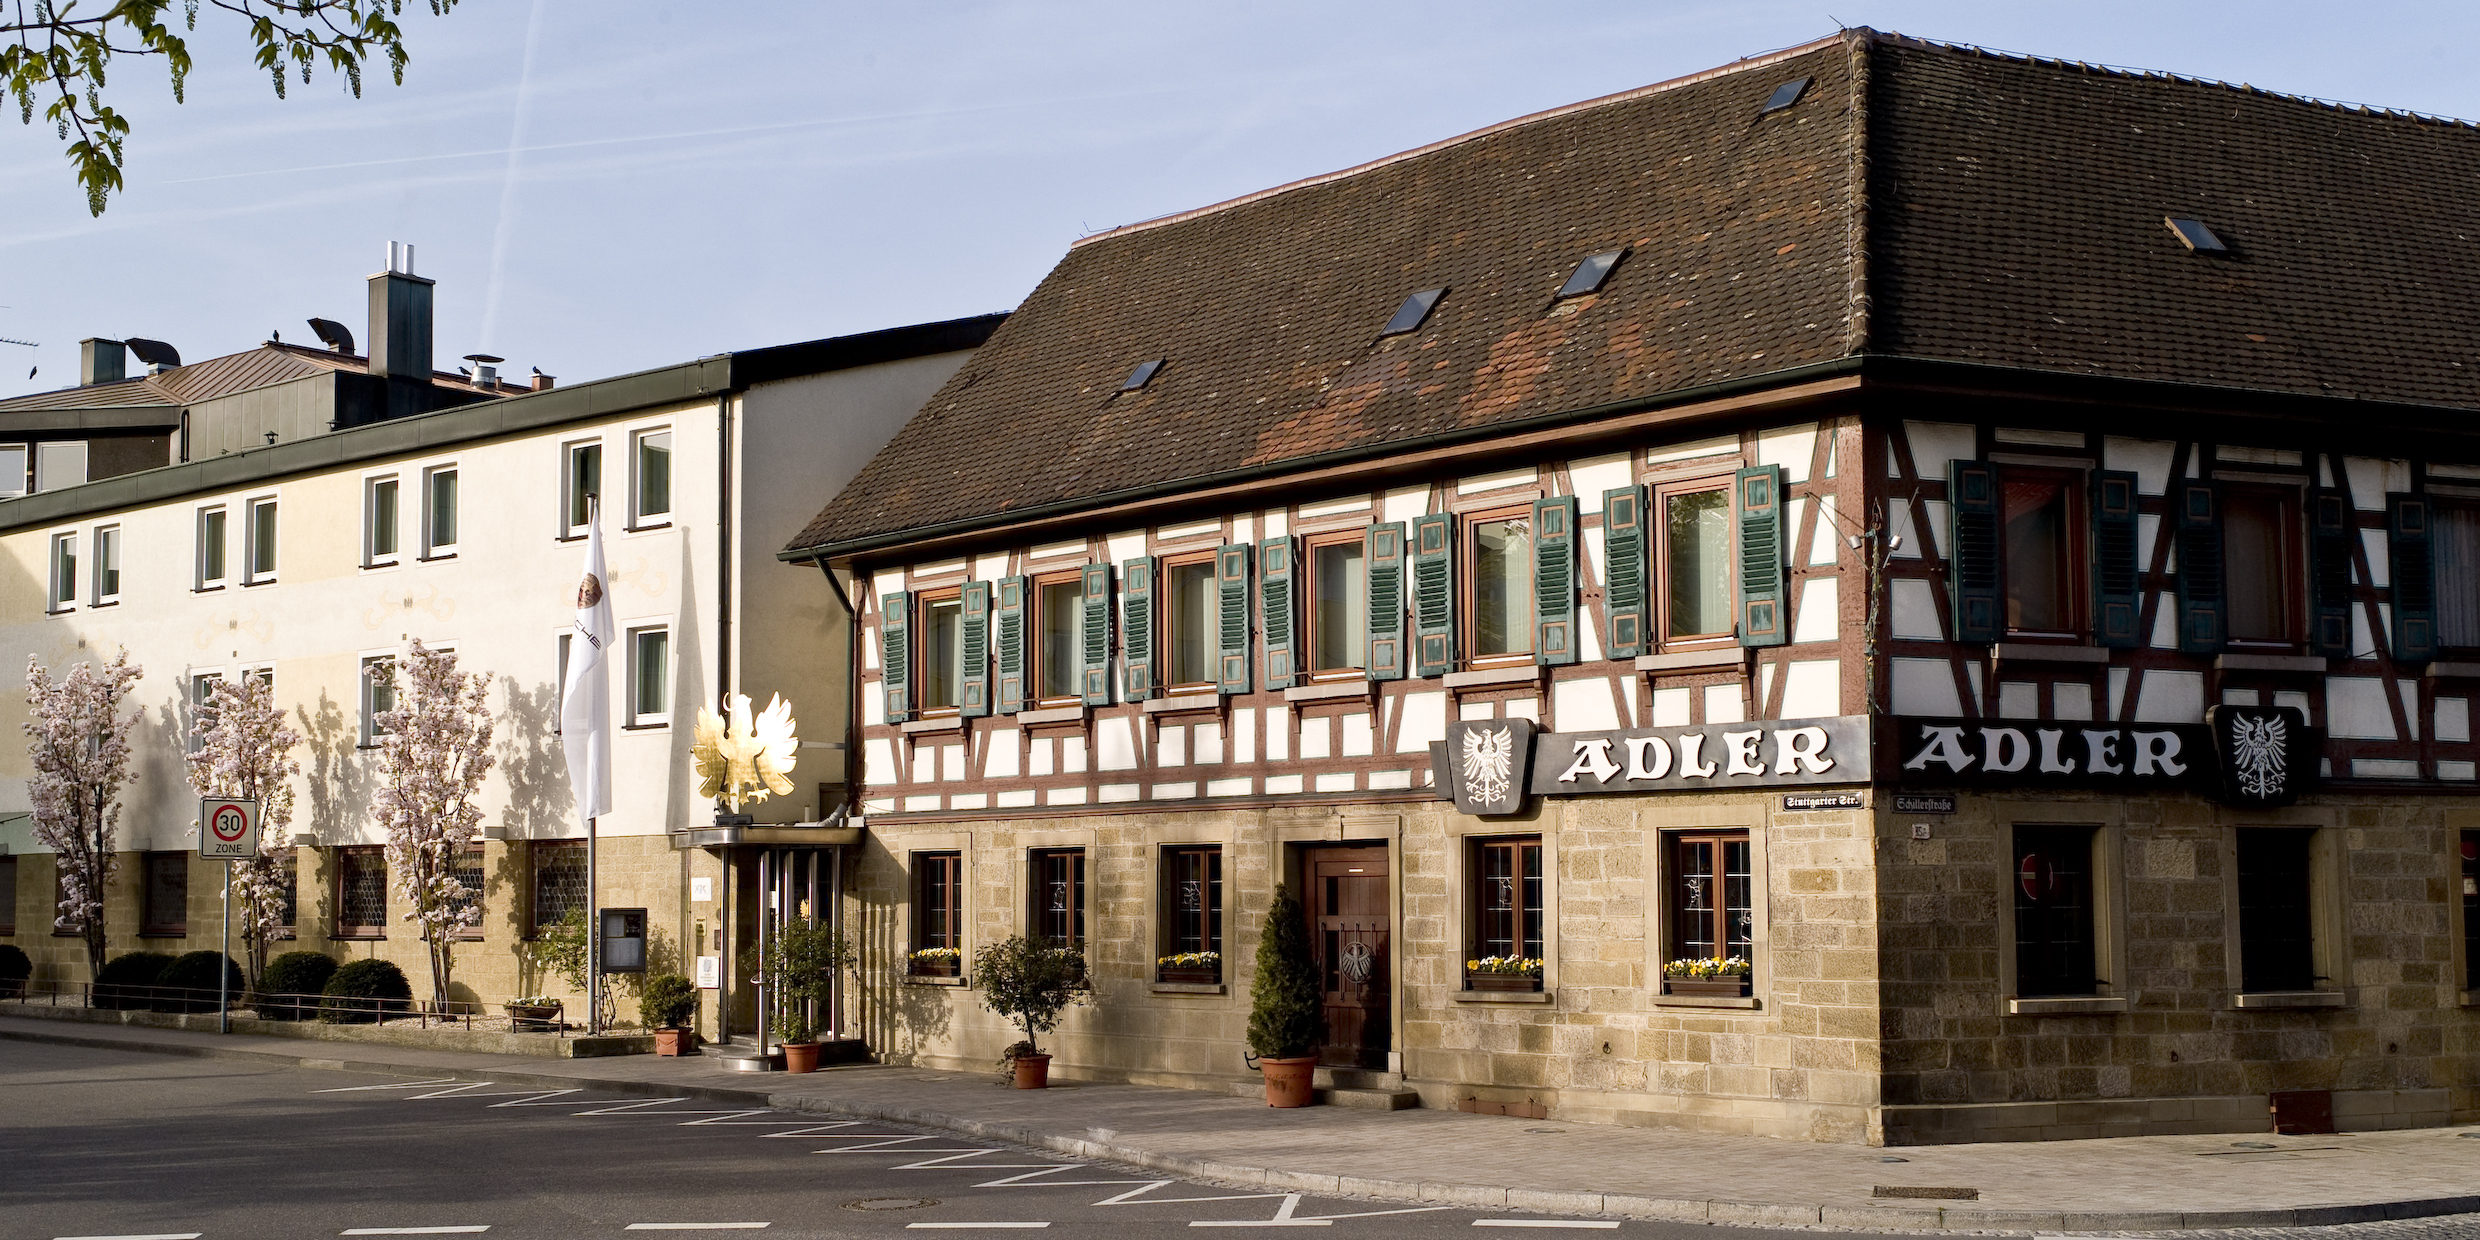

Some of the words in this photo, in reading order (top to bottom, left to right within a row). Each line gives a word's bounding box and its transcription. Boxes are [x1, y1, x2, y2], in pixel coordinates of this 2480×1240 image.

[1557, 726, 1837, 784] ADLER
[1903, 724, 2188, 777] ADLER
[1786, 796, 1837, 808] Stuttgarter
[1838, 795, 1859, 805] Str.
[219, 814, 240, 831] 30
[215, 843, 242, 853] ZONE
